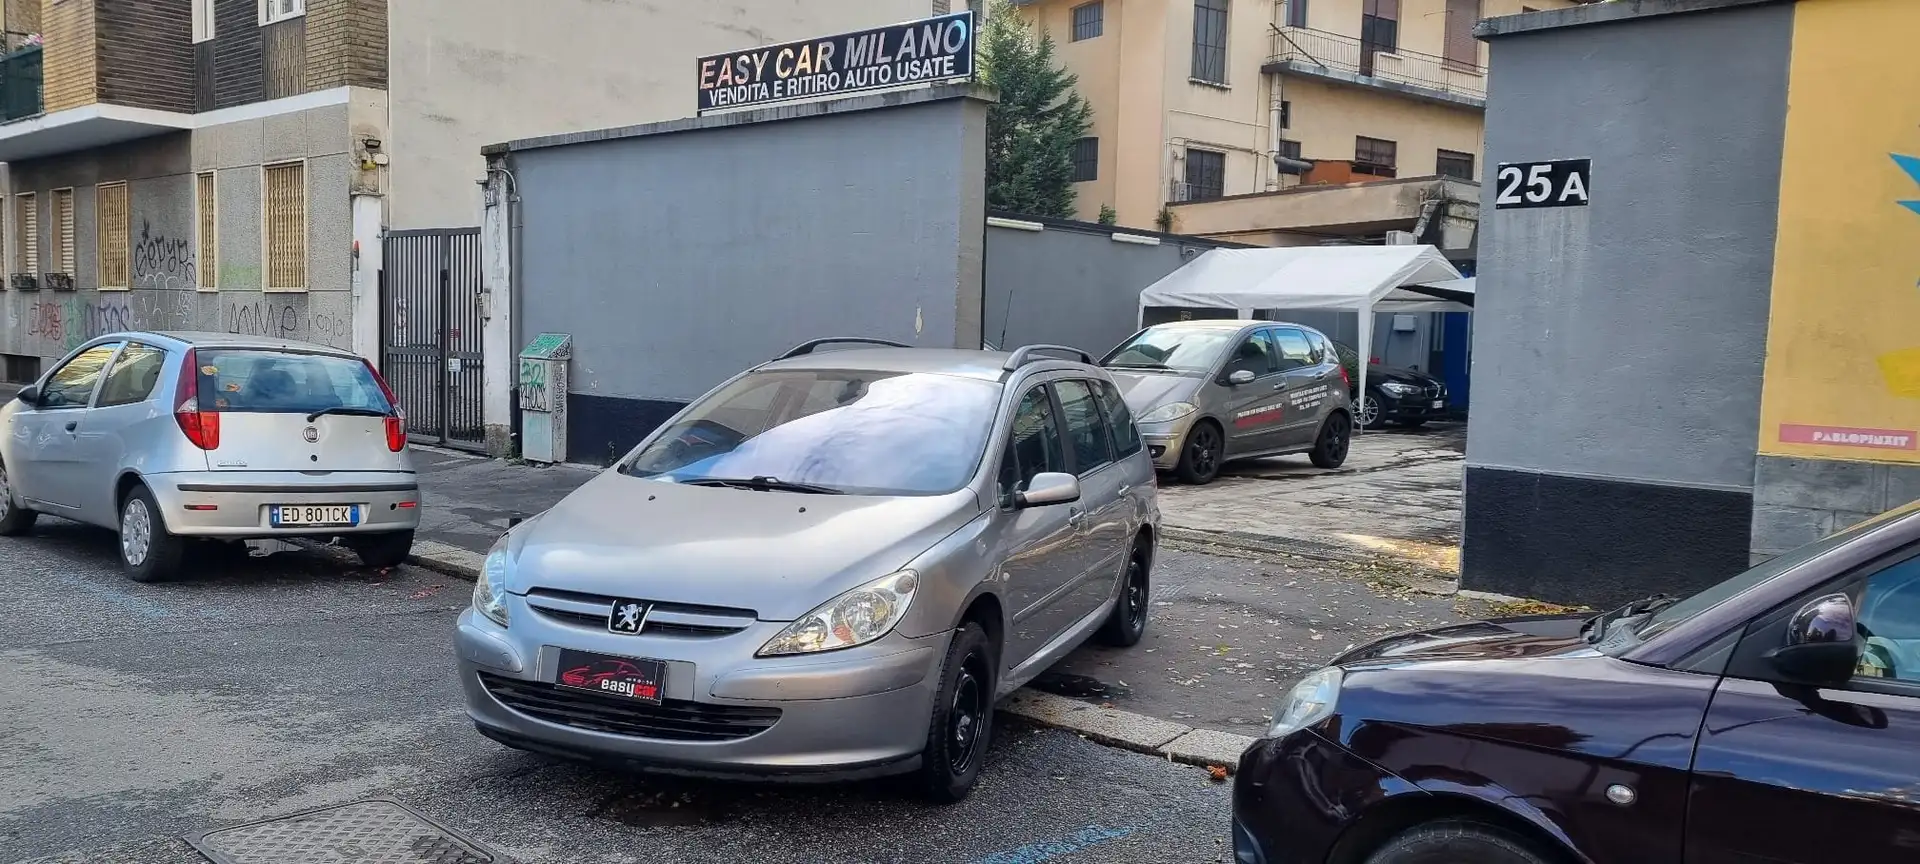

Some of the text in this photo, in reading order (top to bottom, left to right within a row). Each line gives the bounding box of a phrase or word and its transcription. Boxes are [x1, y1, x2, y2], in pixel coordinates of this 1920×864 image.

[700, 20, 966, 90] EASY CAR MILANO
[709, 55, 955, 106] VENDITA E RITIRO AUTO USATE
[1496, 164, 1588, 204] 25 A
[281, 507, 349, 522] ED 801CK
